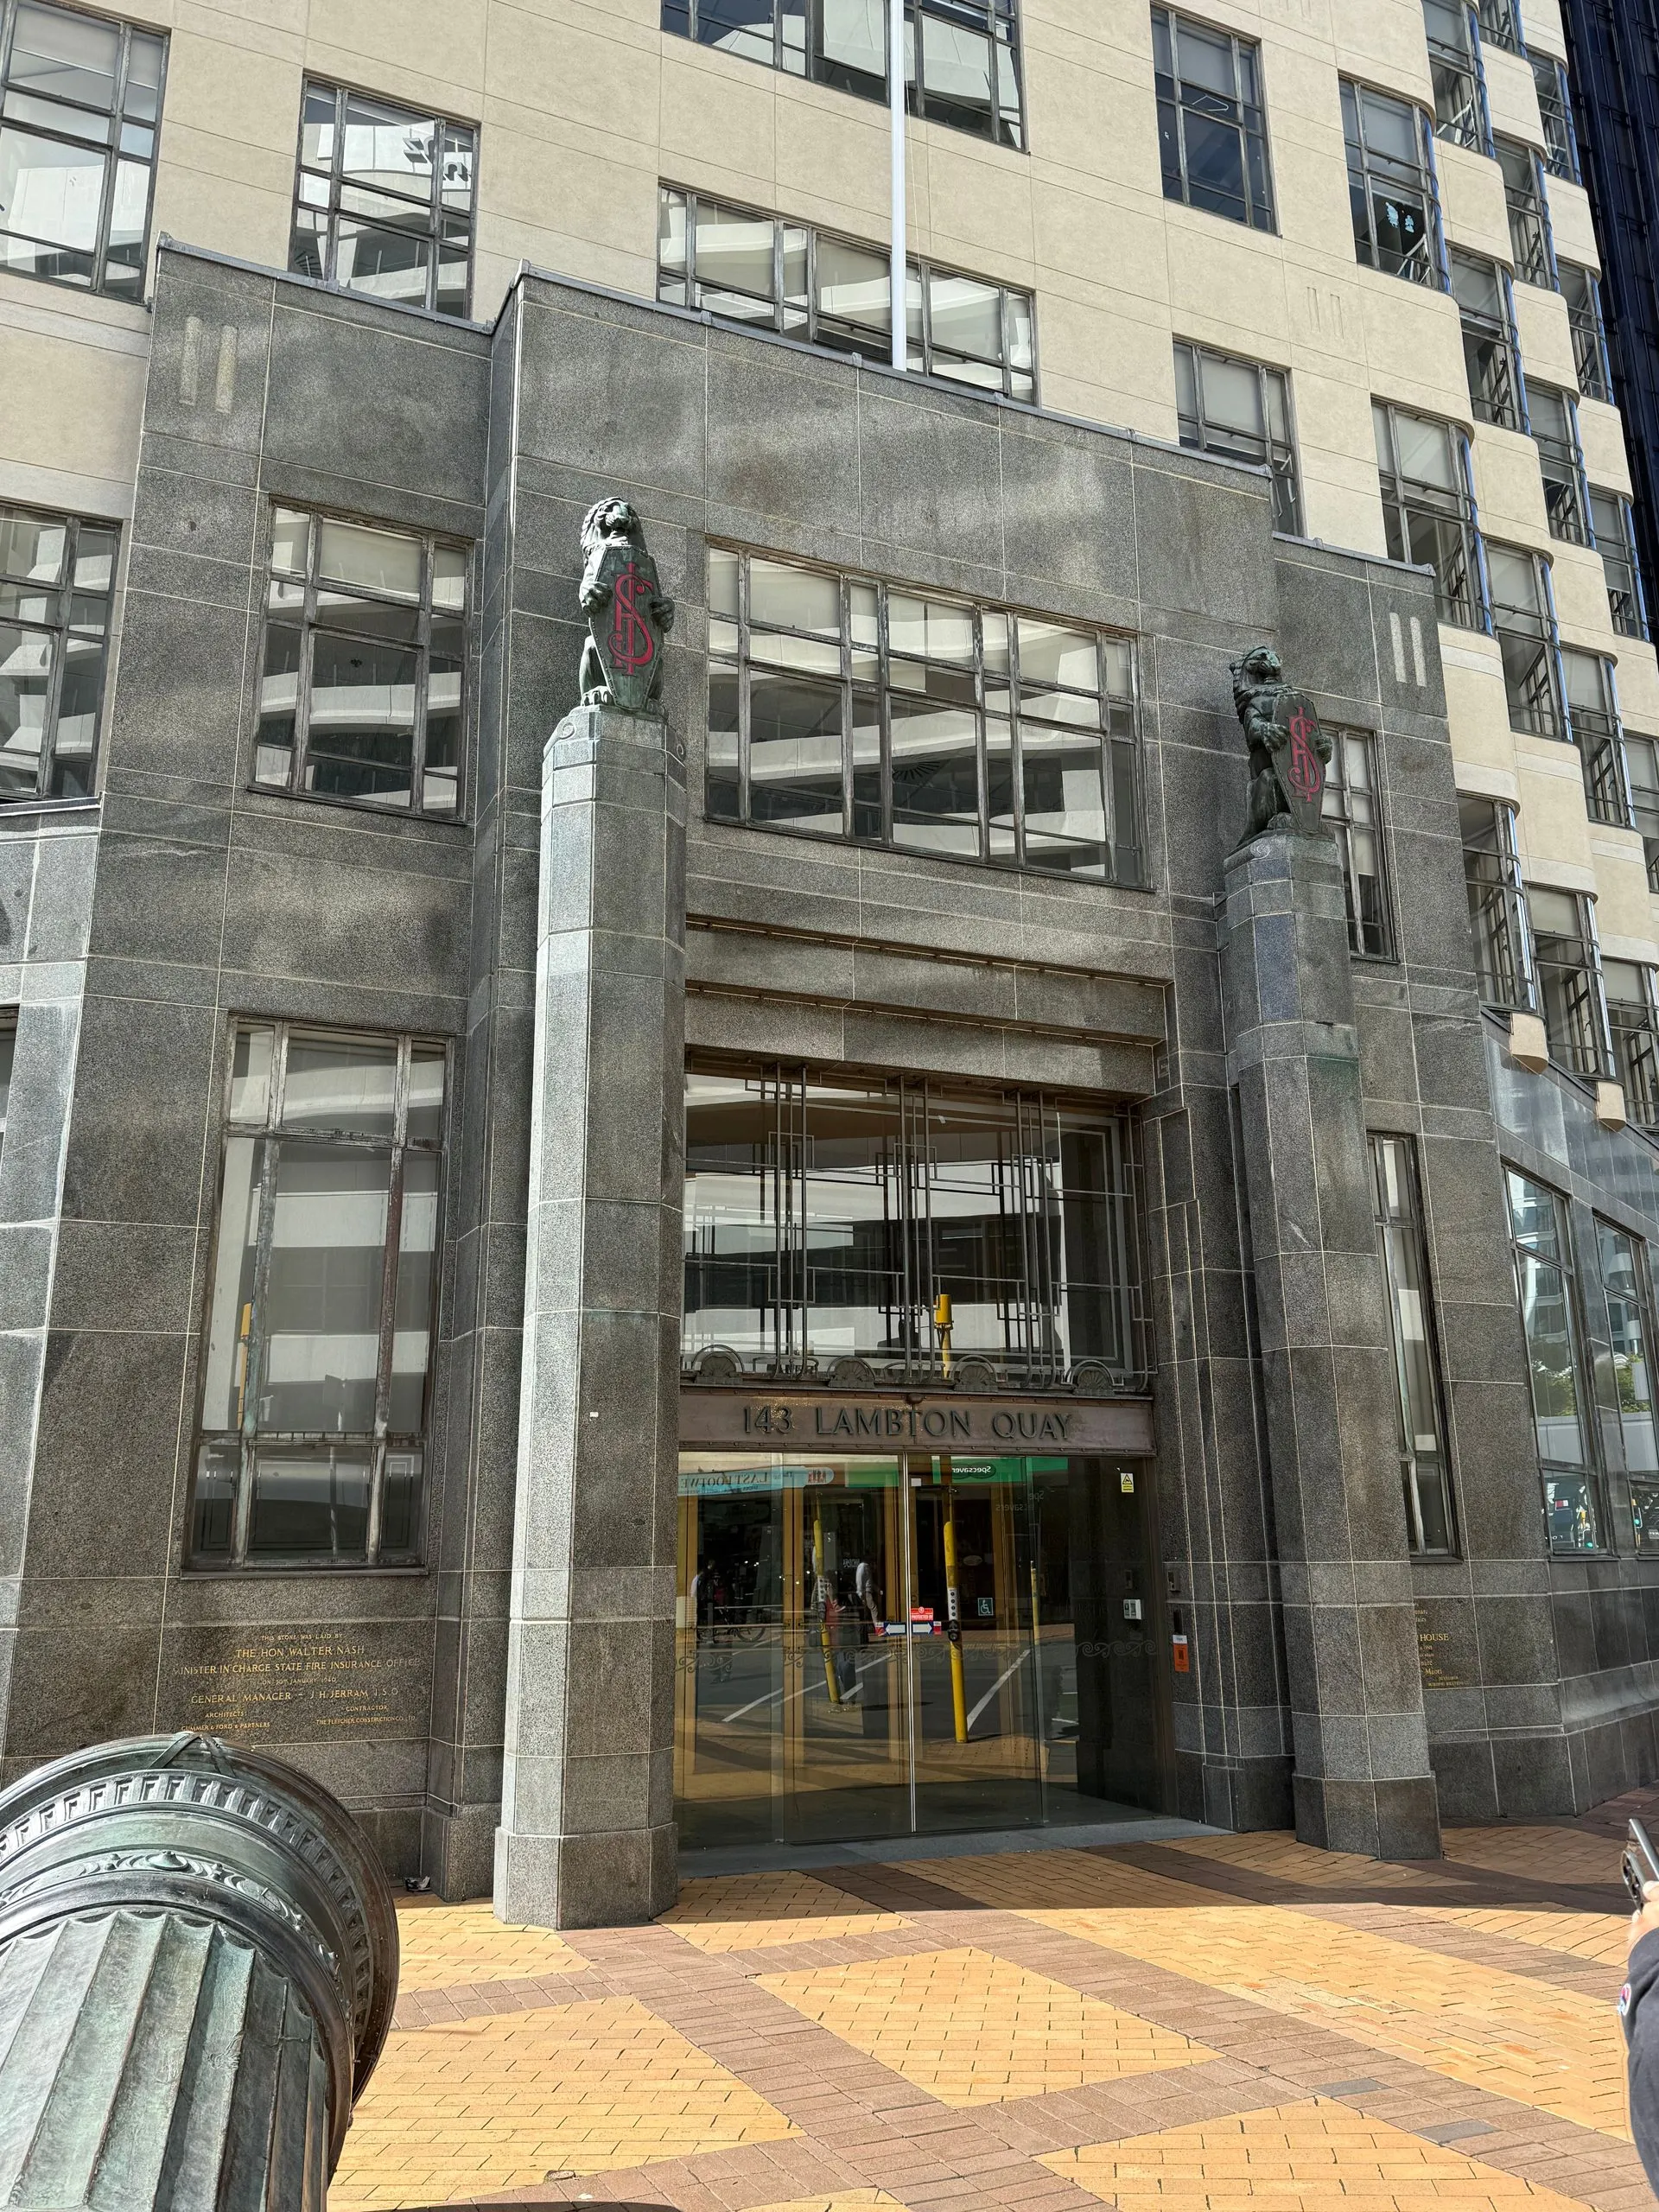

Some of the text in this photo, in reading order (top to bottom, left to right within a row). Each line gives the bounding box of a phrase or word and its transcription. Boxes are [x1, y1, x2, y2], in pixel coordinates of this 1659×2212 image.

[744, 1406, 1071, 1440] 143 LAMBTON QUAY
[235, 1645, 365, 1658] THE HON WALTER NASH
[219, 1664, 230, 1674] IN
[232, 1663, 271, 1674] CHARGE
[275, 1662, 302, 1672] STATE
[306, 1662, 327, 1671] FIRE
[330, 1659, 382, 1670] INSURANCE
[386, 1658, 419, 1669] OFFICE
[191, 1694, 238, 1704] GENERAL
[242, 1692, 291, 1701] MANAGER
[329, 1689, 369, 1699] JERRAM
